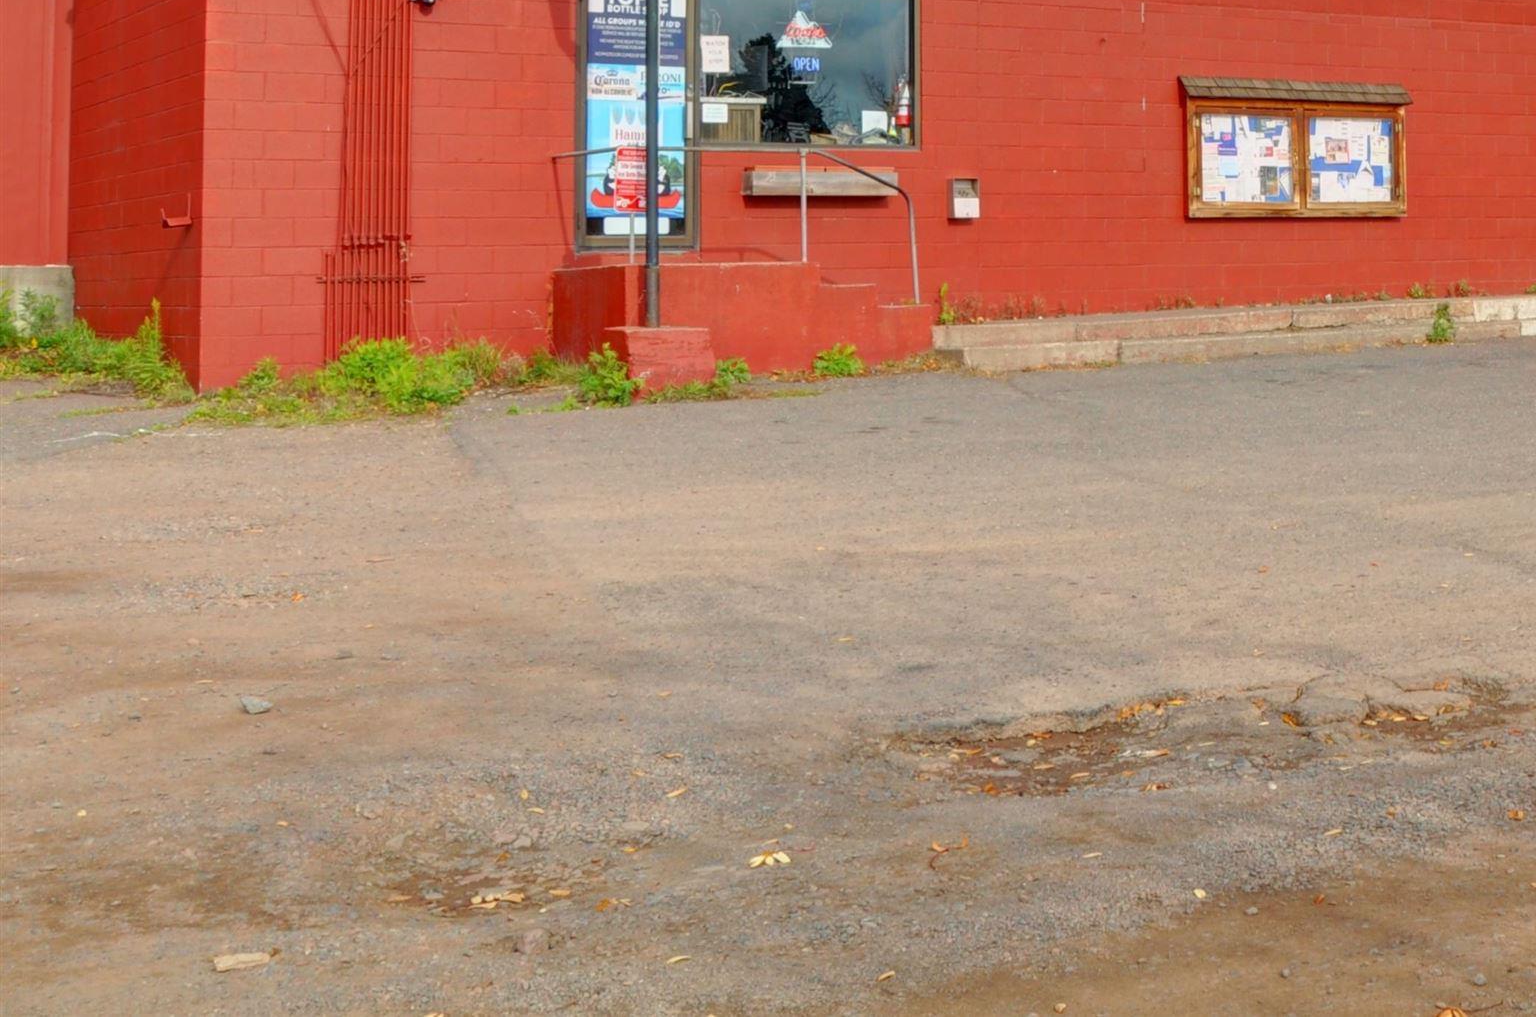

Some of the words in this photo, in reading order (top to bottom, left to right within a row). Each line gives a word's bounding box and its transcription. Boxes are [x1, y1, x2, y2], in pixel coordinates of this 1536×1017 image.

[607, 5, 640, 14] BOTTLE
[607, 18, 637, 26] GROUPS
[793, 57, 820, 71] OPEN
[594, 75, 630, 87] Corona
